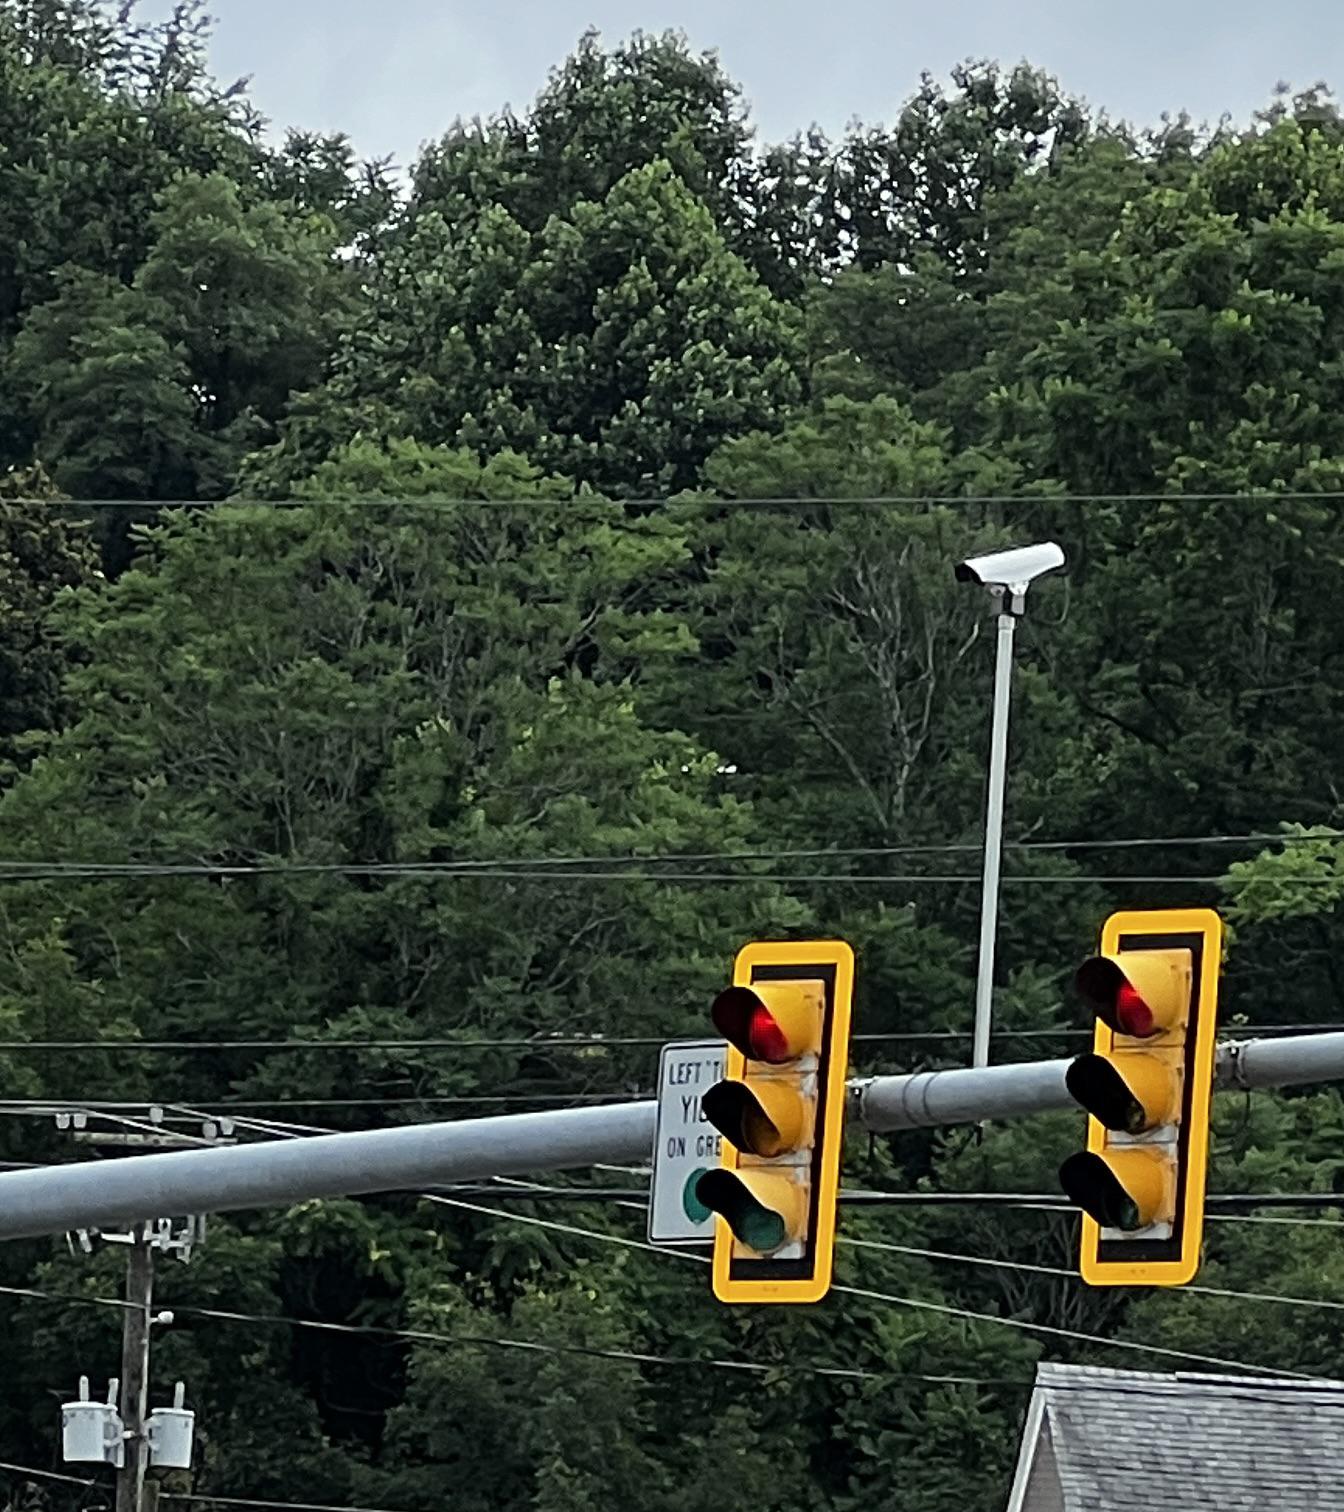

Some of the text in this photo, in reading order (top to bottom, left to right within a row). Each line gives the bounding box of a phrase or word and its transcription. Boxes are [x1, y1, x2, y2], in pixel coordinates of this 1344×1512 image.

[668, 1062, 701, 1085] LEFT
[667, 1135, 722, 1158] ON GRE
